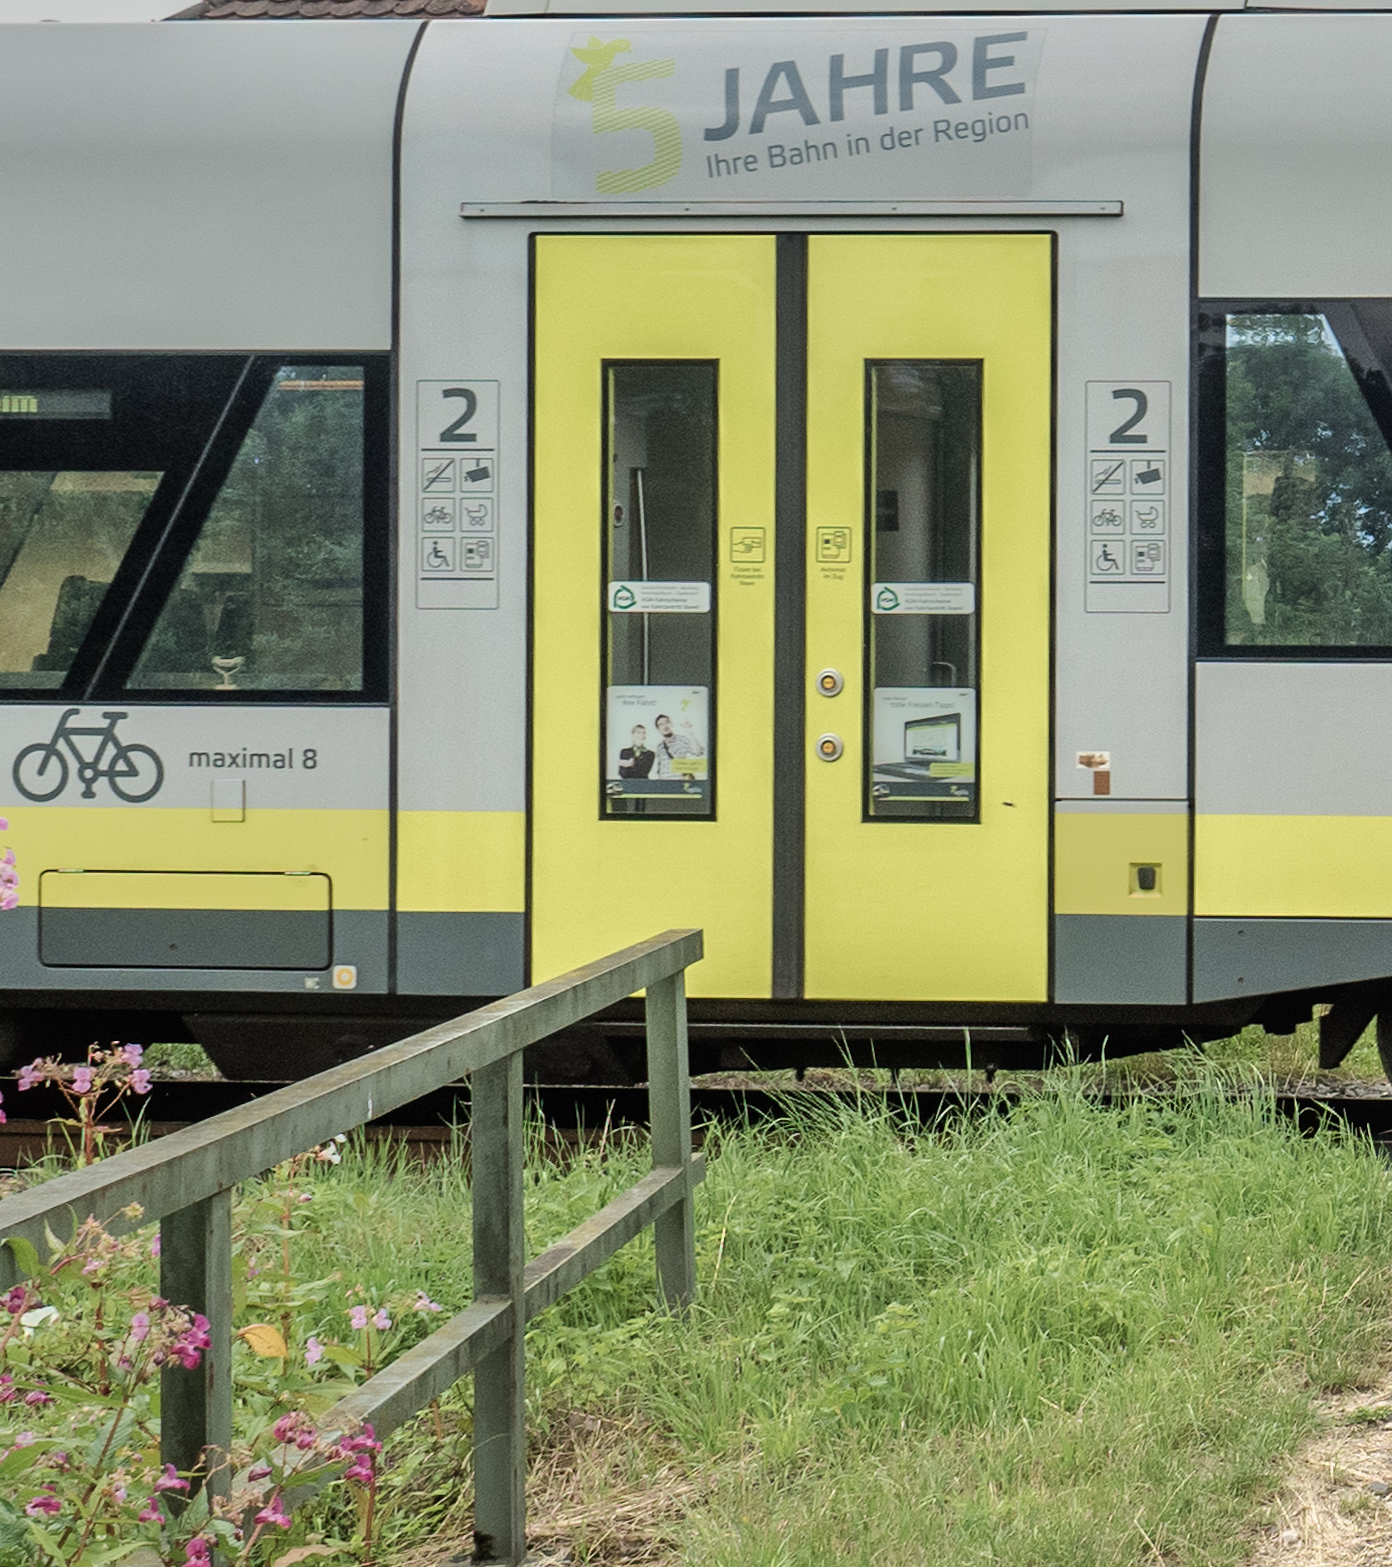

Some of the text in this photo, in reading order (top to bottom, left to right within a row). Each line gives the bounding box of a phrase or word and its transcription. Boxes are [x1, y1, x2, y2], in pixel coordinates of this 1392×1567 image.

[593, 31, 1029, 194] 5 JAHRE
[706, 111, 1029, 178] Ihre Bahn in der Region
[440, 387, 477, 442] 2
[1109, 388, 1148, 444] 2
[188, 747, 318, 770] maximal 8
